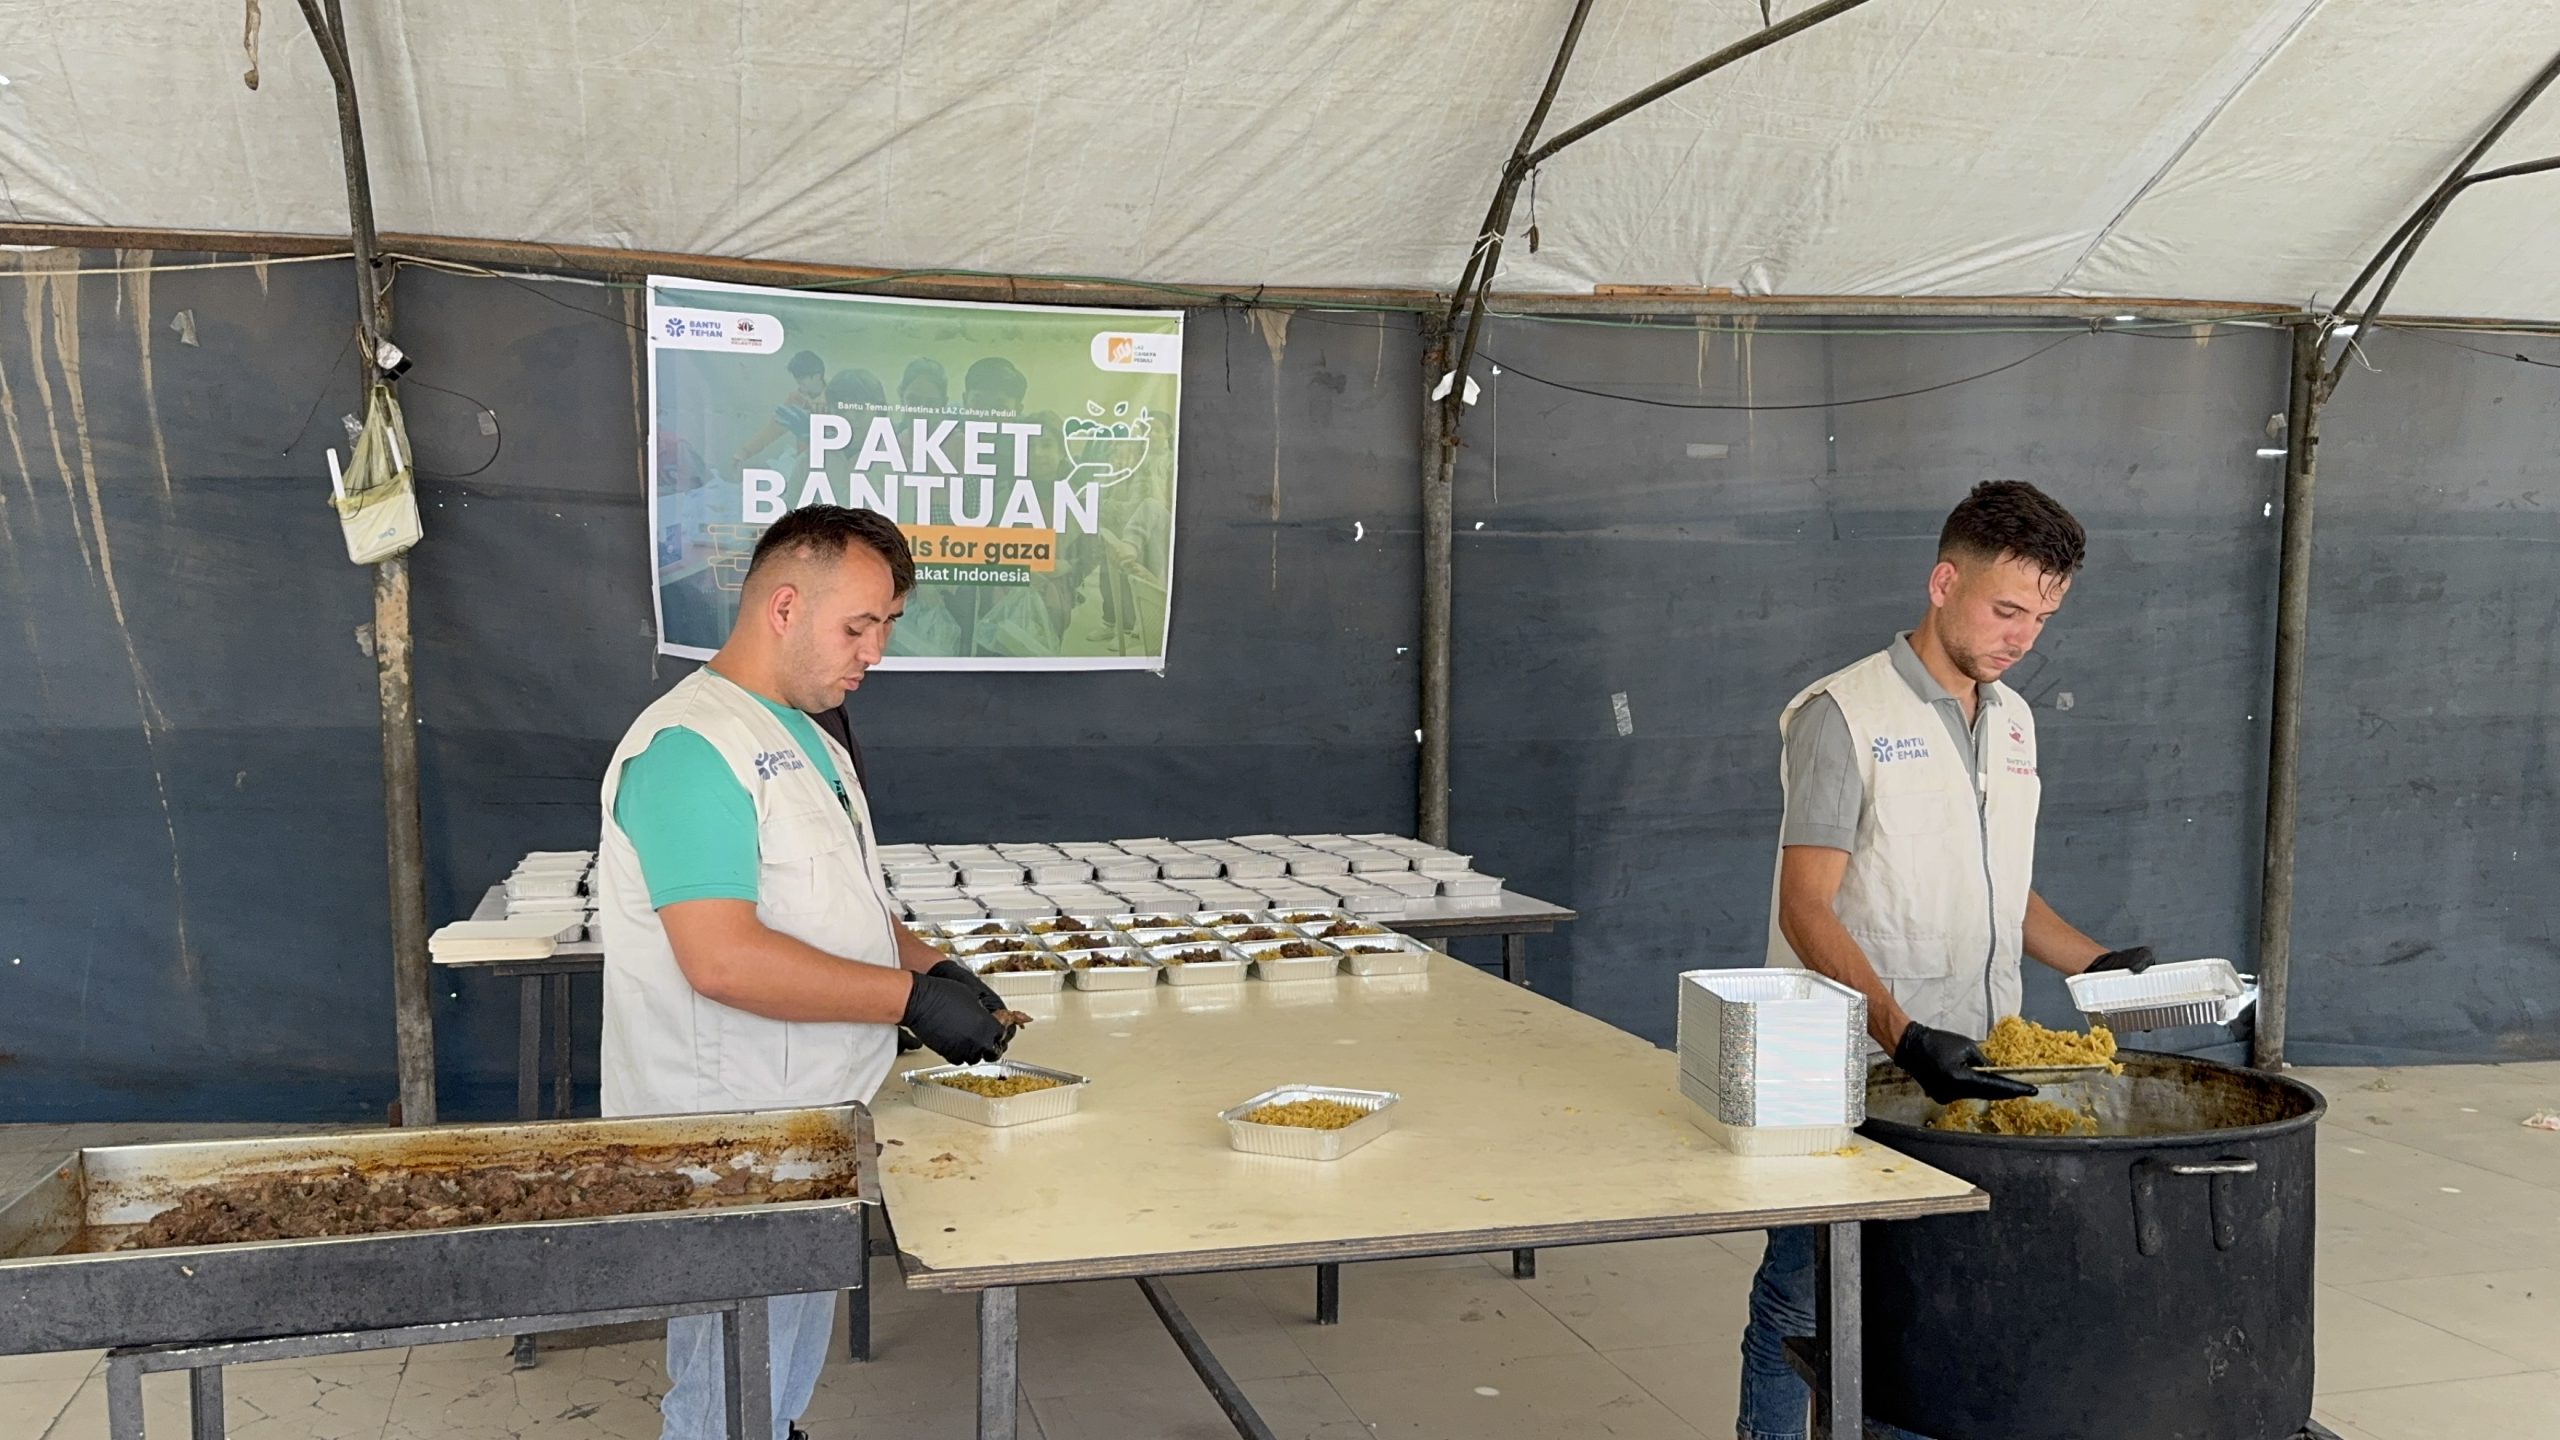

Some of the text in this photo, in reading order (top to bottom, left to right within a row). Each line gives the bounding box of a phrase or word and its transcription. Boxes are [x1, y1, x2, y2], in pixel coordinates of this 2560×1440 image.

[689, 320, 721, 330] BANTU
[690, 329, 723, 338] TEMAN
[837, 401, 864, 411] Bantu
[864, 402, 894, 412] Teman
[895, 403, 933, 414] Palestina
[941, 406, 958, 415] LAZ
[959, 407, 990, 418] Cahaya
[991, 408, 1017, 418] Peduli
[810, 413, 1042, 477] PAKET
[742, 468, 1099, 534] BANTUAN
[939, 535, 978, 558] for
[984, 542, 1050, 565] gaza
[914, 566, 1030, 583] akat Indonesia
[1896, 737, 1925, 749] ANTU
[1896, 748, 1929, 760] EMAN
